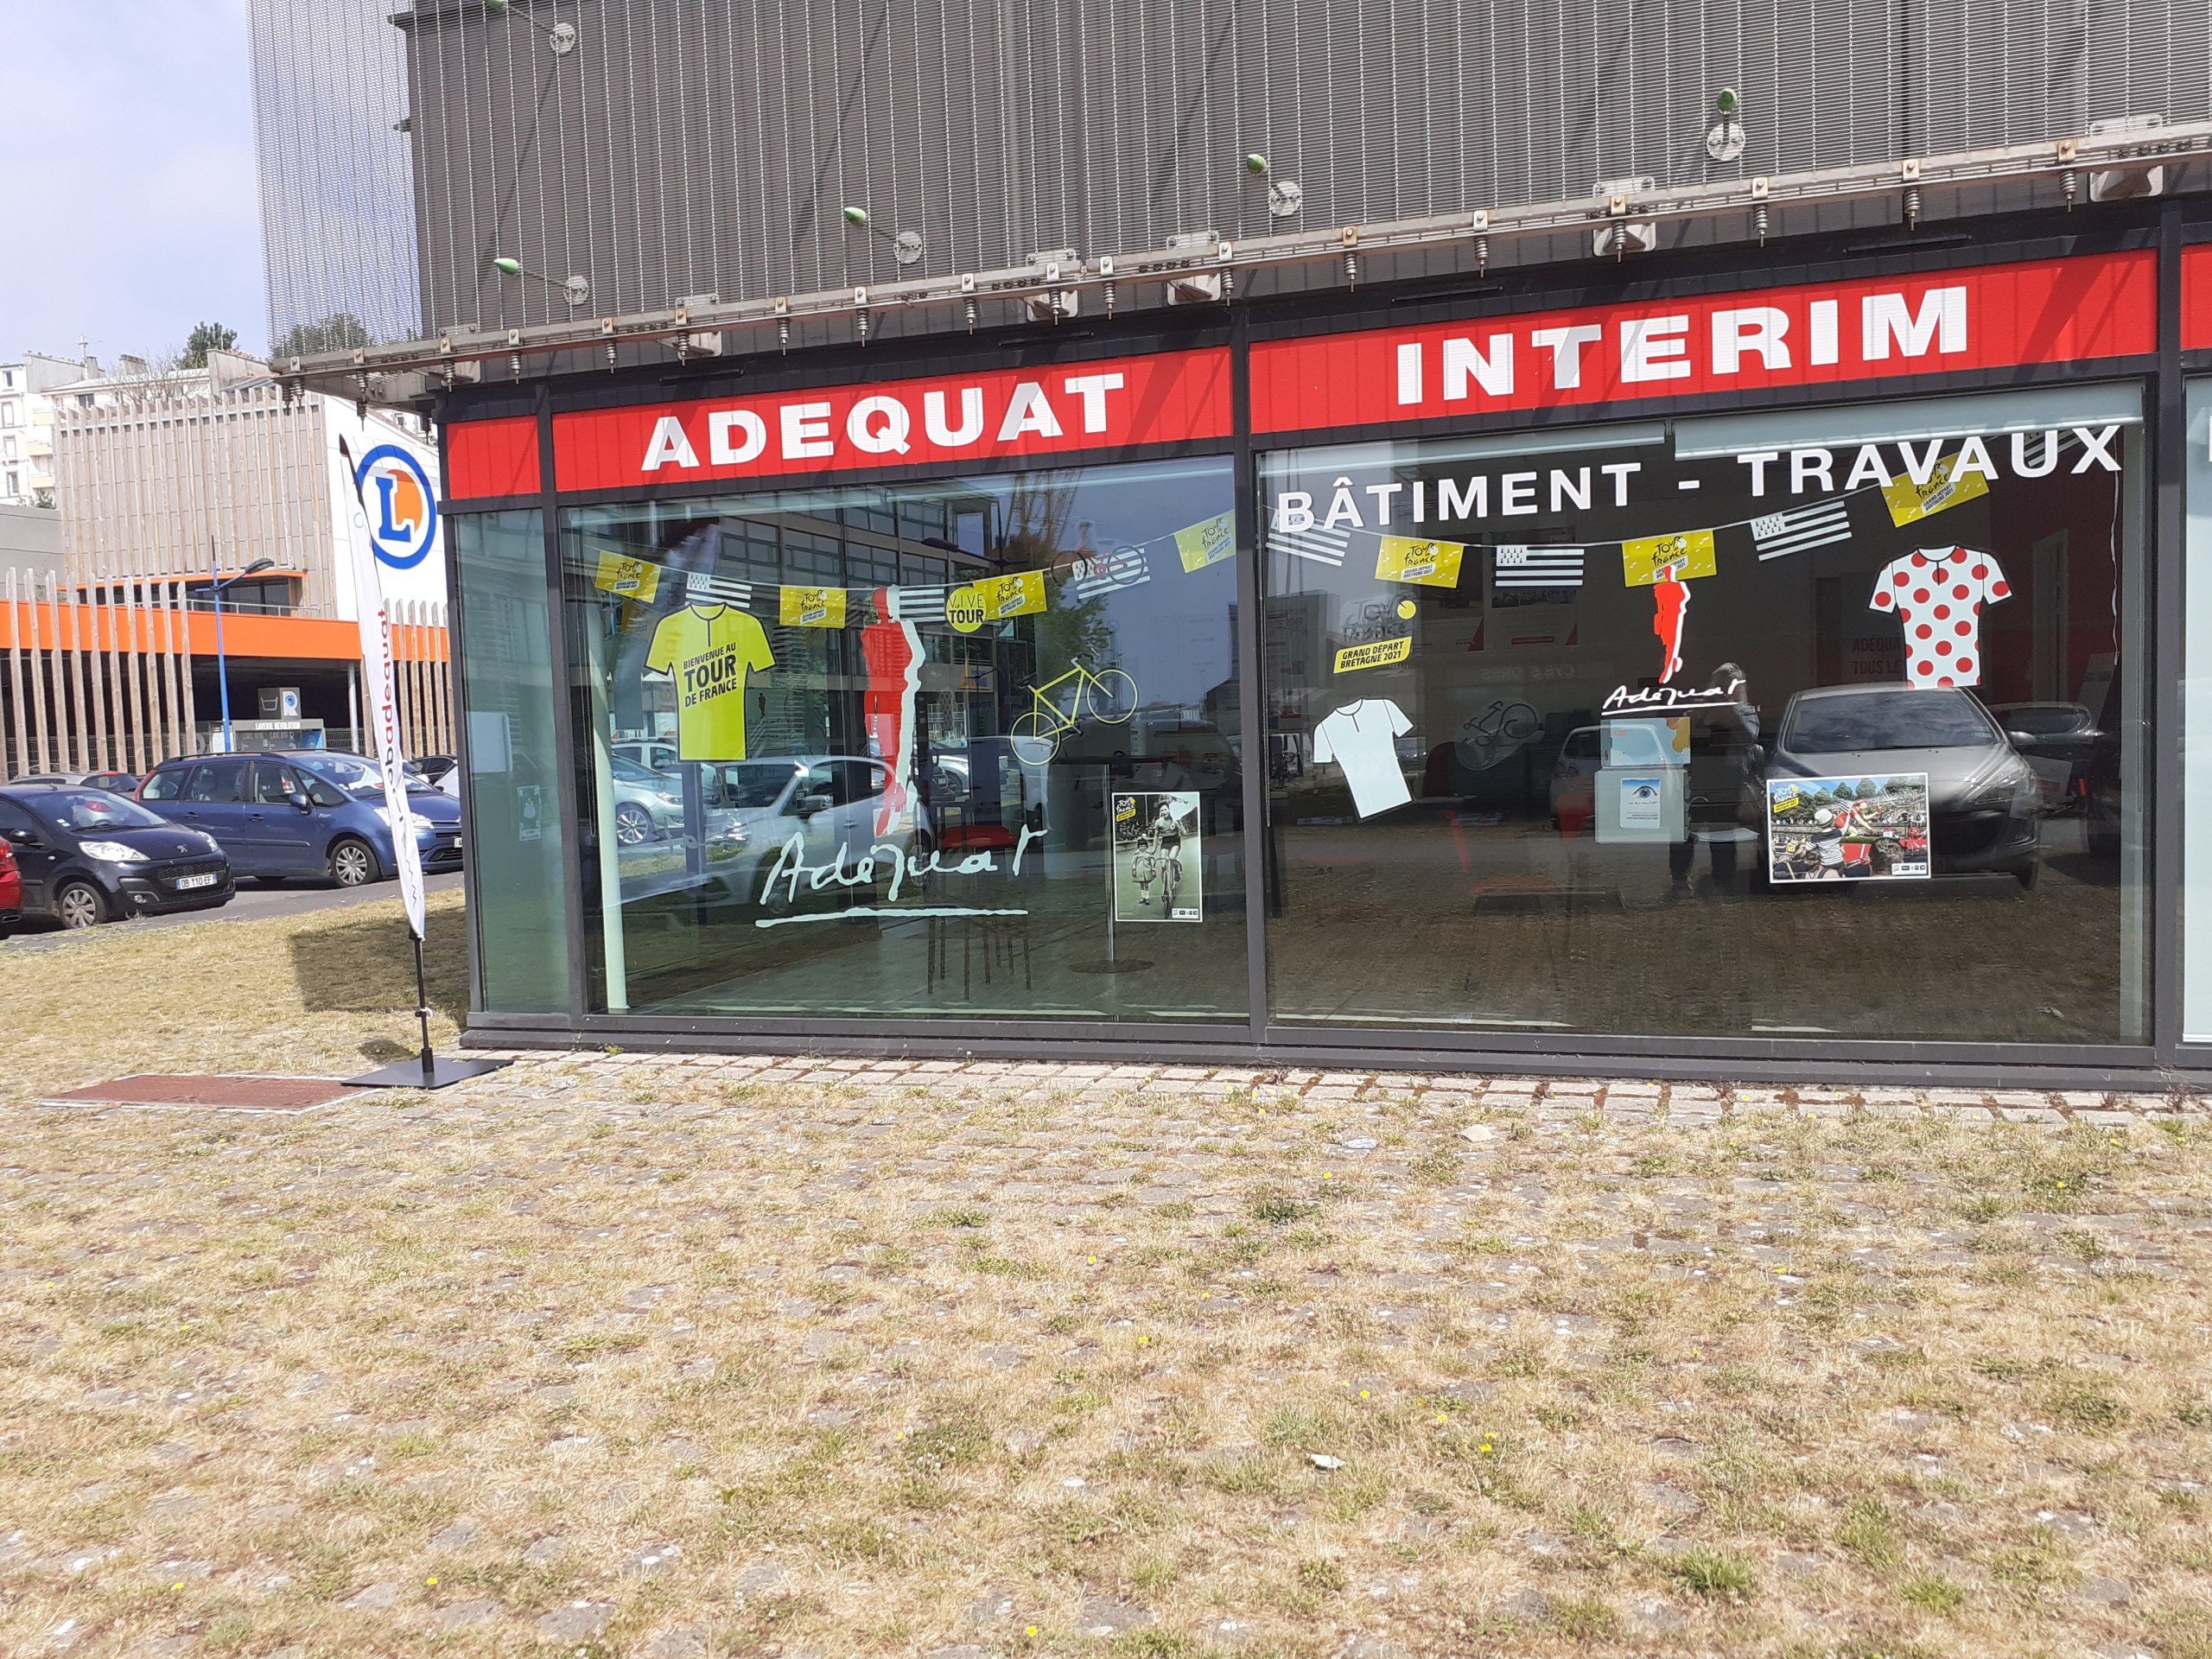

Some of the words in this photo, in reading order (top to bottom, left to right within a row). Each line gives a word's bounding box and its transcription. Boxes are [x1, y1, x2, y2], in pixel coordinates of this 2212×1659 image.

[641, 372, 1124, 471] ADEQUAT
[1397, 286, 1967, 405] INTERIM
[1278, 461, 1642, 534] BÂTIMENT
[1737, 425, 2123, 498] TRAVAUX
[949, 609, 983, 623] TOUR
[683, 646, 724, 670] BIENVENUE
[726, 642, 736, 654] AU
[1340, 654, 1381, 669] BRETAGNE
[1383, 651, 1401, 661] 2021
[1342, 648, 1371, 660] GRAND
[1372, 641, 1404, 654] DÉPART
[684, 654, 736, 693] TOUR
[685, 693, 696, 708] DE
[699, 677, 737, 702] FRANCE
